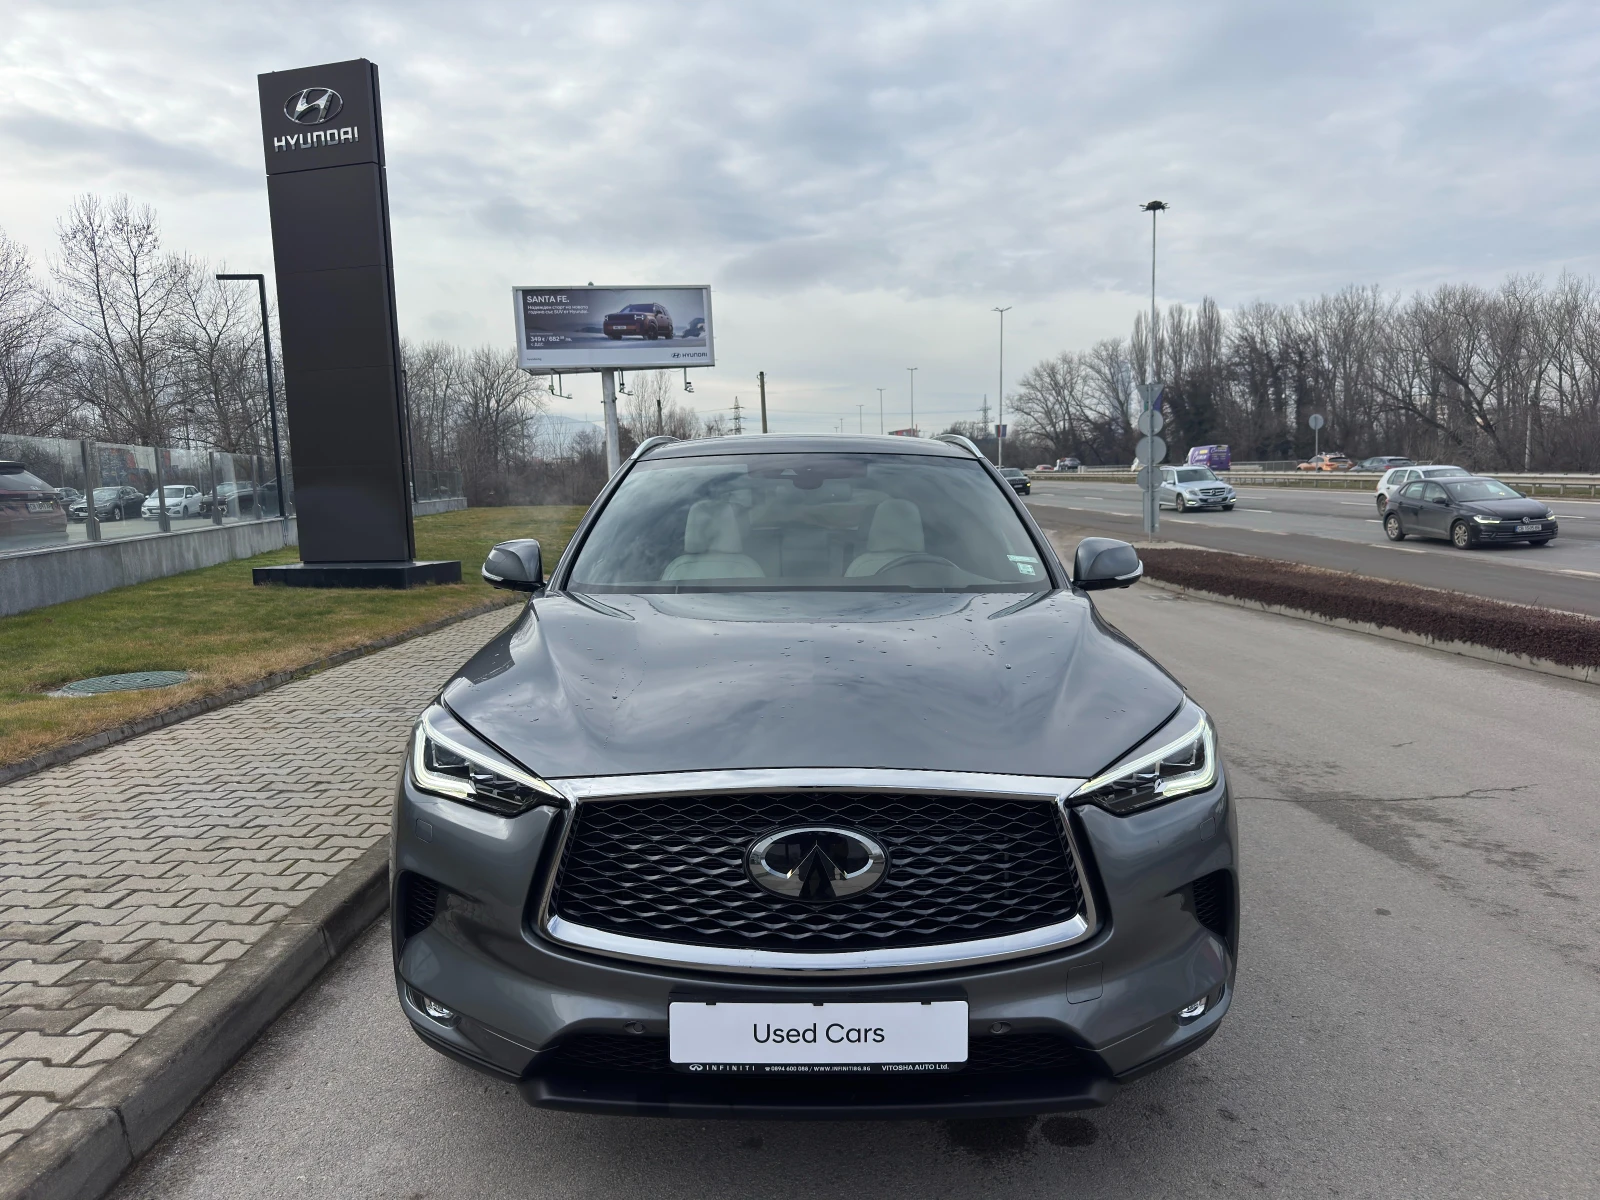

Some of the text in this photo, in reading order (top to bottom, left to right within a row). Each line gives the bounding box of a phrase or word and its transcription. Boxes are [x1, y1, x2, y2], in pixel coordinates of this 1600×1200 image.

[273, 126, 359, 152] HYUNDAI
[526, 295, 570, 303] SANTA FE.
[753, 1022, 886, 1043] Used Cars
[914, 1063, 935, 1071] AUTO
